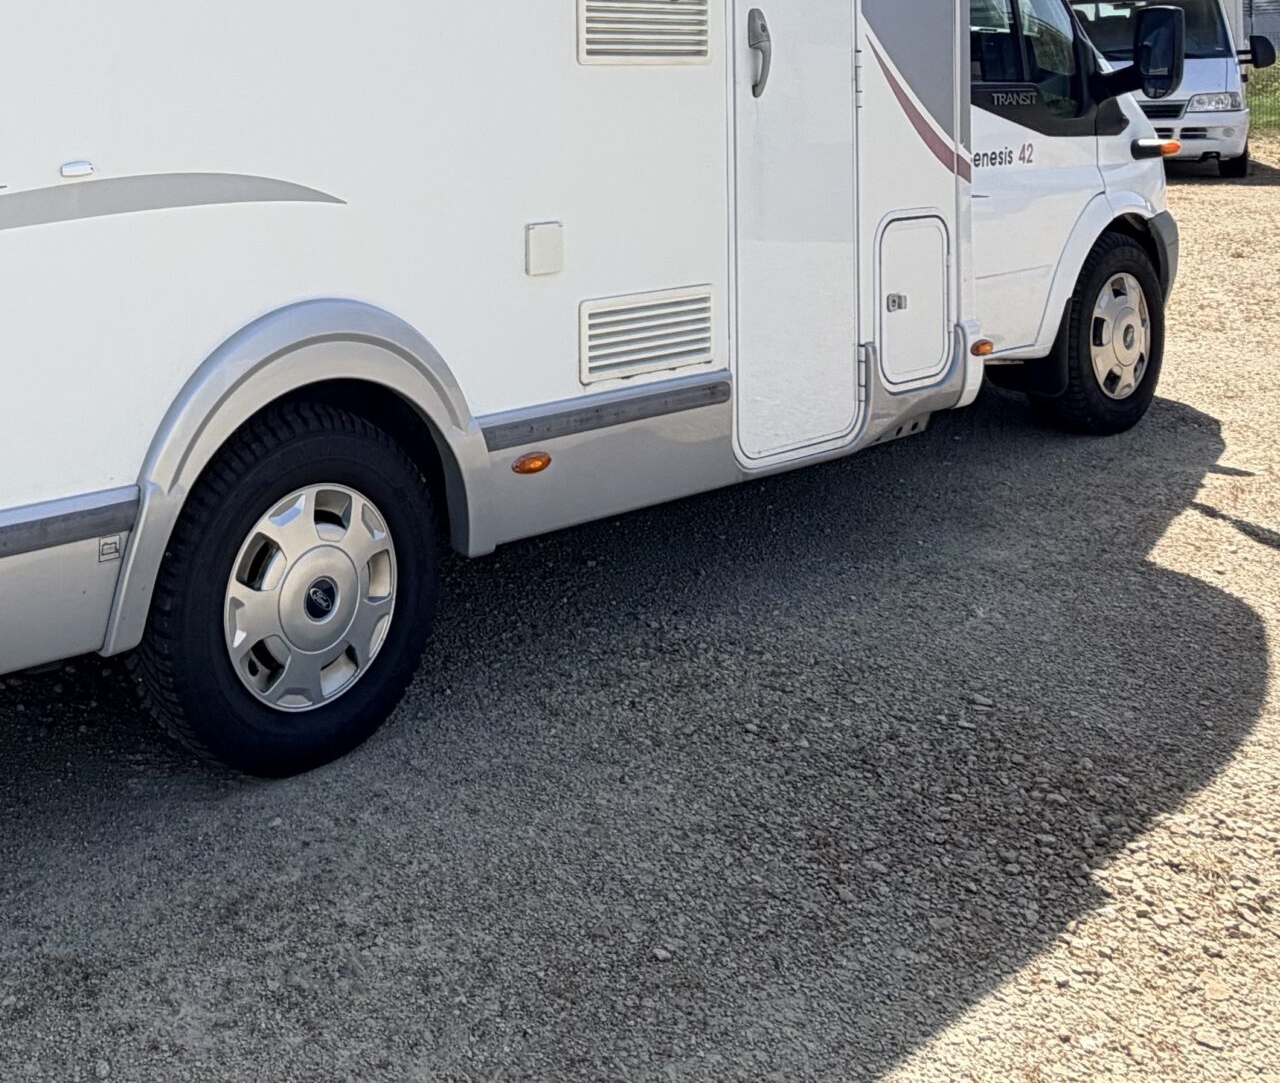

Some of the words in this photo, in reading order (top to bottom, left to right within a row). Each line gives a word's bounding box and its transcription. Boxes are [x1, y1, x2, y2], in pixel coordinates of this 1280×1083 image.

[992, 92, 1038, 106] TRANSIT
[971, 146, 1014, 168] enesis
[1018, 143, 1034, 164] 42
